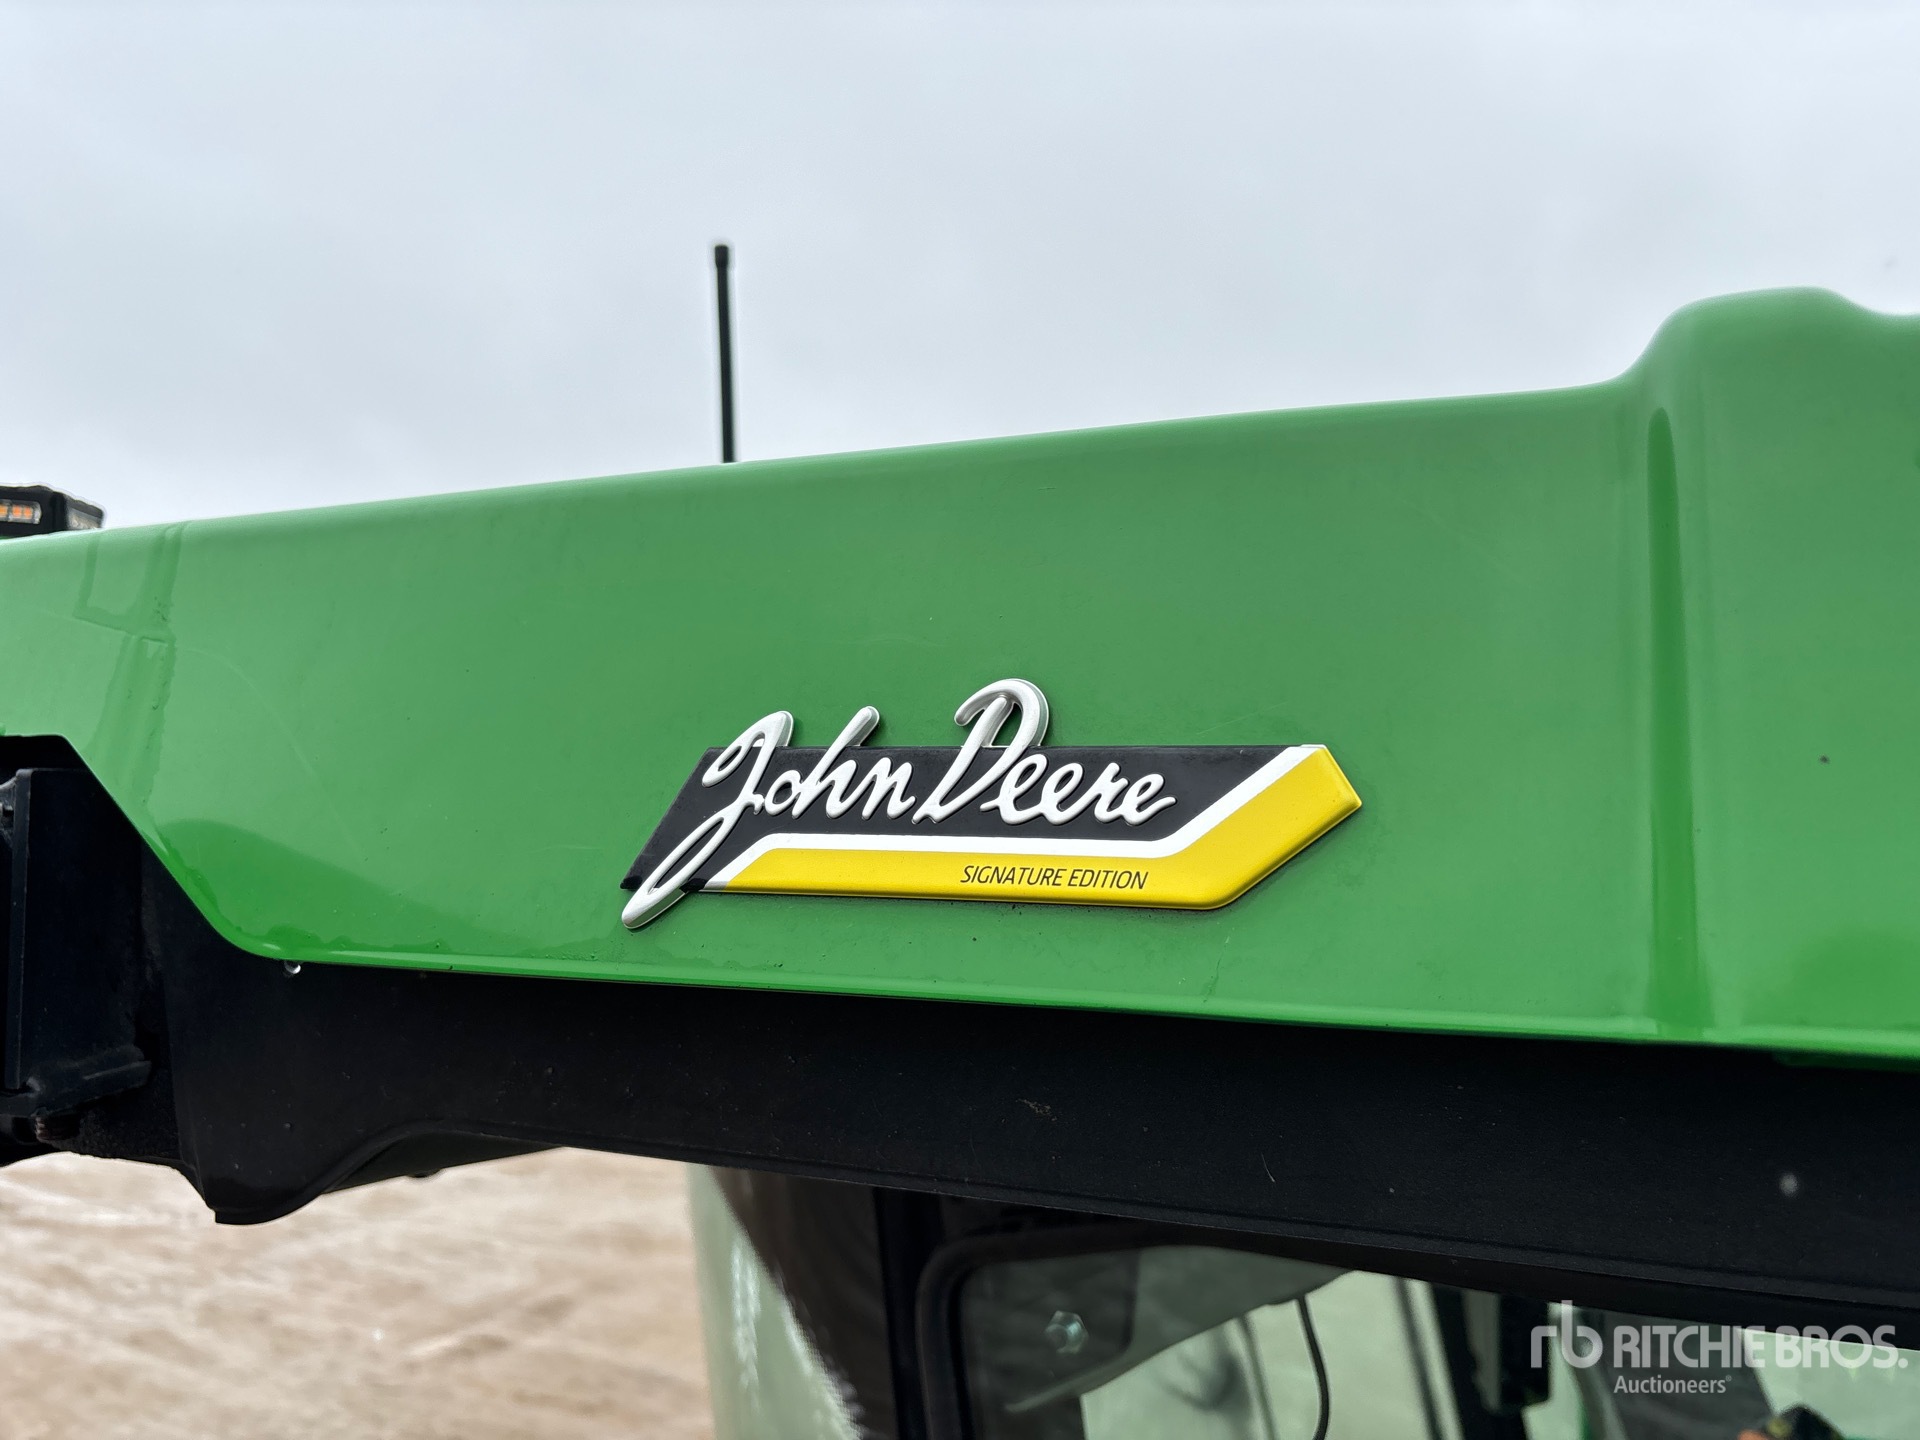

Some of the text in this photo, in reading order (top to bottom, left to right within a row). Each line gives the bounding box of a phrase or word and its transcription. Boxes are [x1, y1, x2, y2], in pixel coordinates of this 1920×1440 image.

[621, 679, 1177, 930] John Deere
[960, 865, 1149, 889] SIGNATURE EDITION
